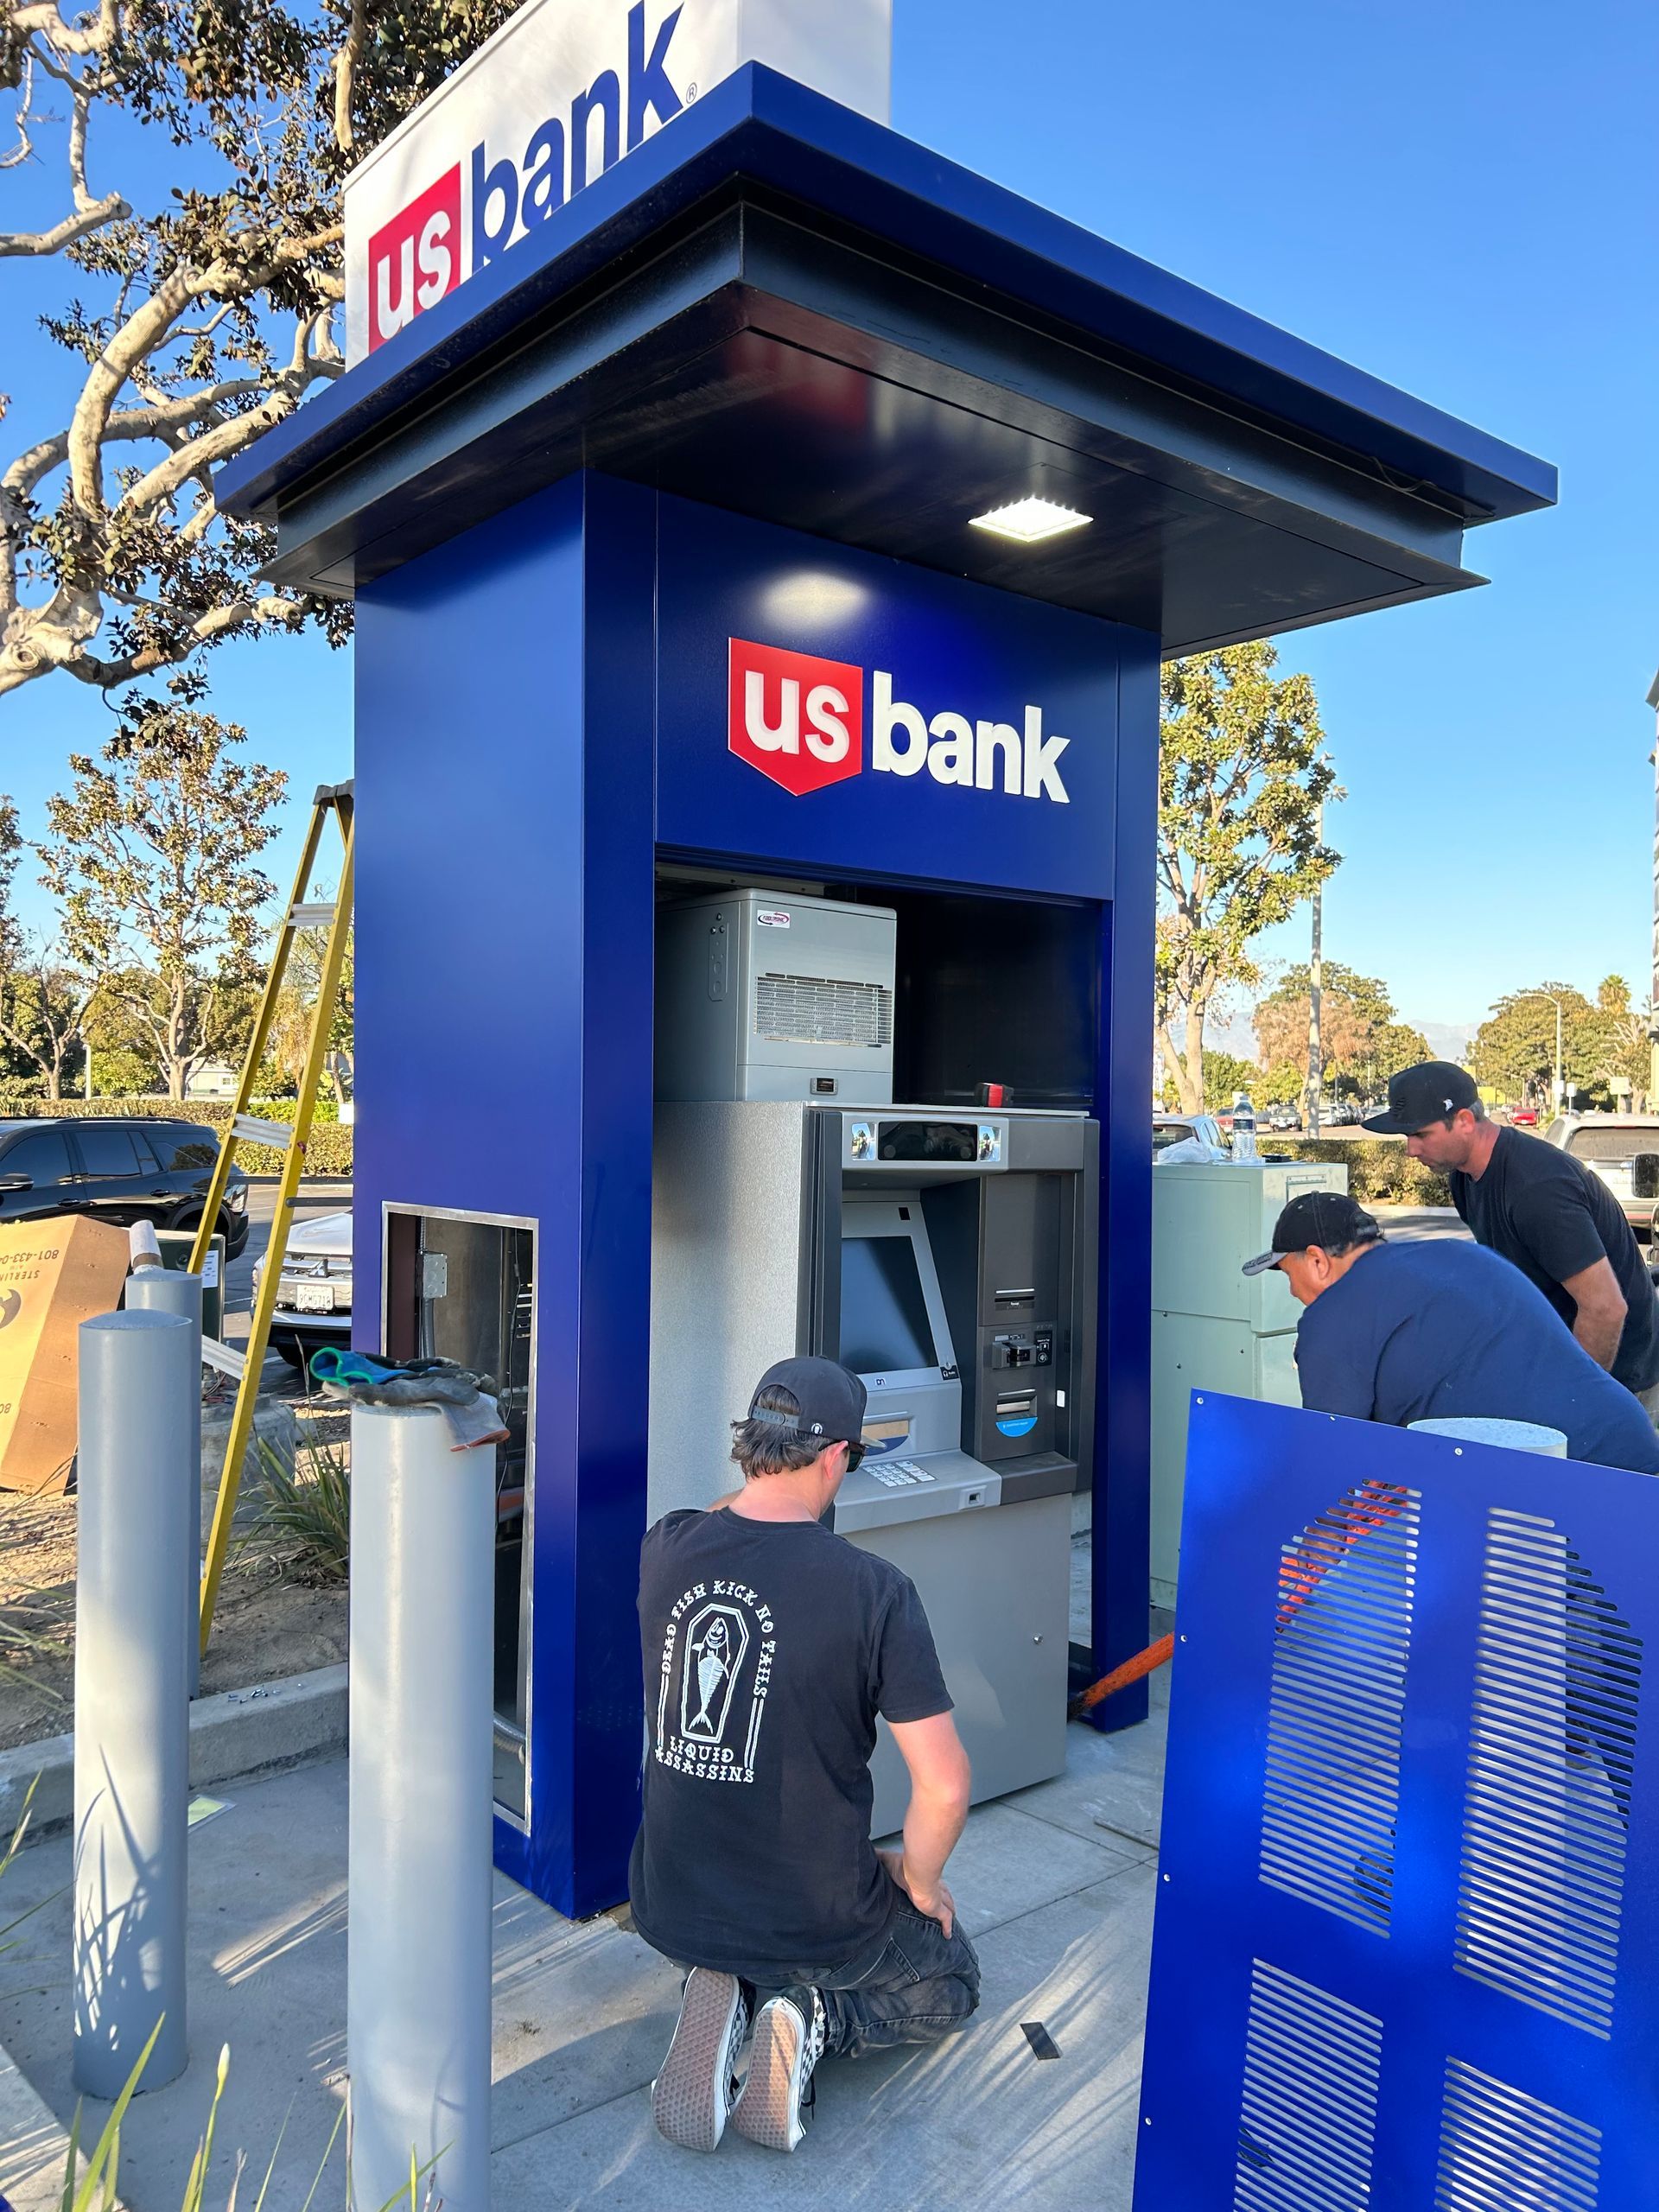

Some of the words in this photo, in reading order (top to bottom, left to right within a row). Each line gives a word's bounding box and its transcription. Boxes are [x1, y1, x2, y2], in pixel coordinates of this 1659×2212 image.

[378, 210, 451, 340] us
[472, 0, 685, 273] bank
[745, 670, 850, 764] us
[872, 670, 1071, 804] bank
[0, 1249, 60, 1265] 801-433-0
[671, 1583, 707, 1620] FISH
[712, 1580, 759, 1607] KICK
[754, 1604, 774, 1633] NO
[661, 1624, 677, 1675] DEAD
[753, 1640, 777, 1699] TAILS
[654, 1746, 755, 1783] ASSASSINS
[670, 1735, 734, 1764] LIQUID
